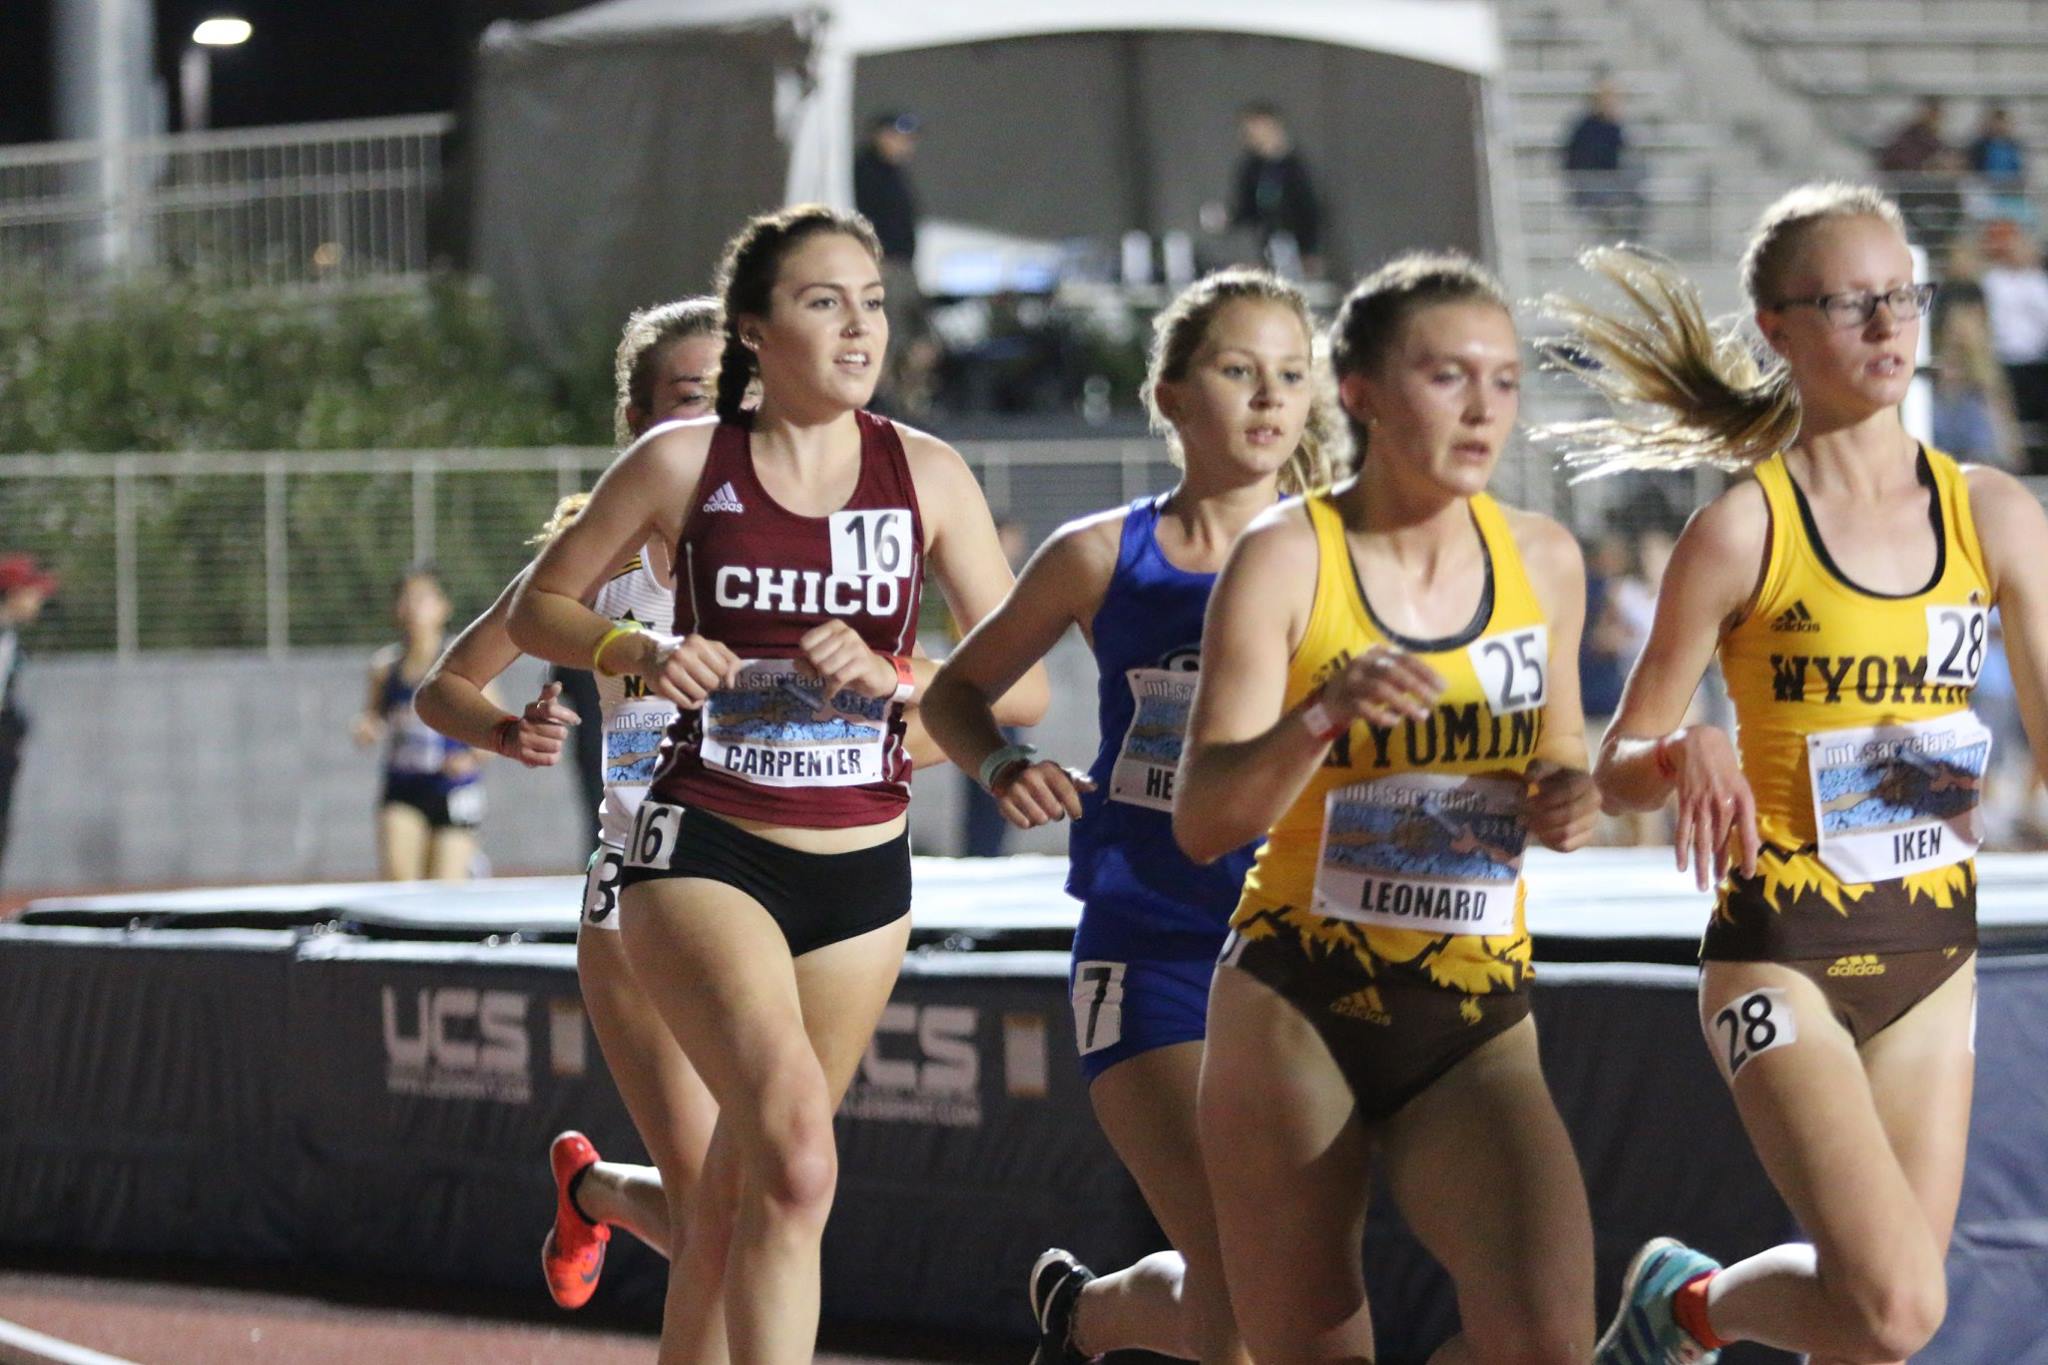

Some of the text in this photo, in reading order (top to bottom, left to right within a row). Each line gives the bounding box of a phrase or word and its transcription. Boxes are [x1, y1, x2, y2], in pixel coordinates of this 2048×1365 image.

[703, 501, 744, 513] adidas
[845, 513, 900, 573] 16
[715, 566, 899, 616] CHICO
[1769, 621, 1821, 633] adidas
[1937, 611, 1984, 680] 28
[1483, 633, 1544, 708] 25
[725, 745, 862, 777] CARPENTER
[631, 805, 670, 864] 16
[1893, 826, 1943, 865] IKEN
[1360, 879, 1488, 922] LEONARD
[1827, 962, 1886, 976] adidas
[381, 985, 531, 1070] UCS
[1083, 967, 1112, 1049] 7
[1716, 994, 1777, 1075] 28
